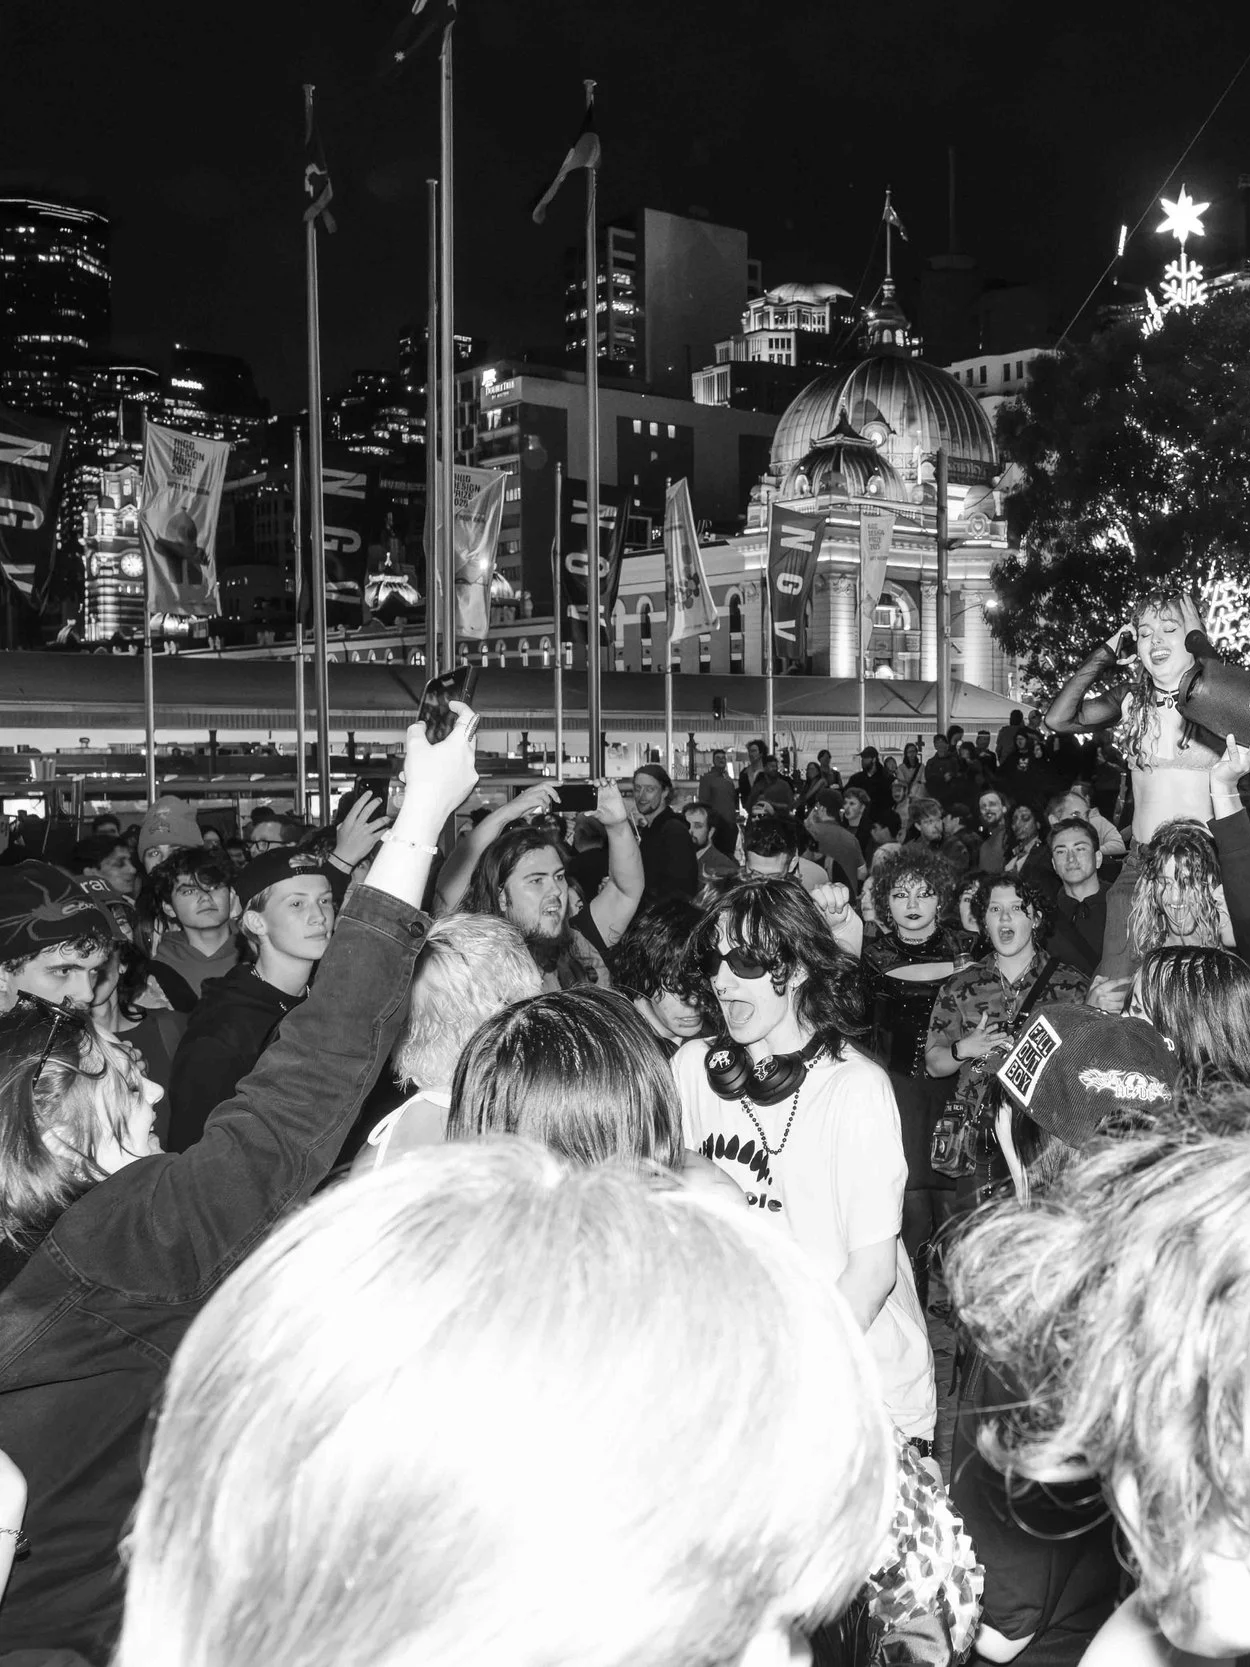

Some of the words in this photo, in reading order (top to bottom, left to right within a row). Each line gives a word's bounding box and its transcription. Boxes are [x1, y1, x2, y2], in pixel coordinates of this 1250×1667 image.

[774, 524, 816, 642] NGV
[1030, 1024, 1053, 1056] FALL
[1018, 1043, 1041, 1072] OUT
[1006, 1060, 1031, 1092] BOY
